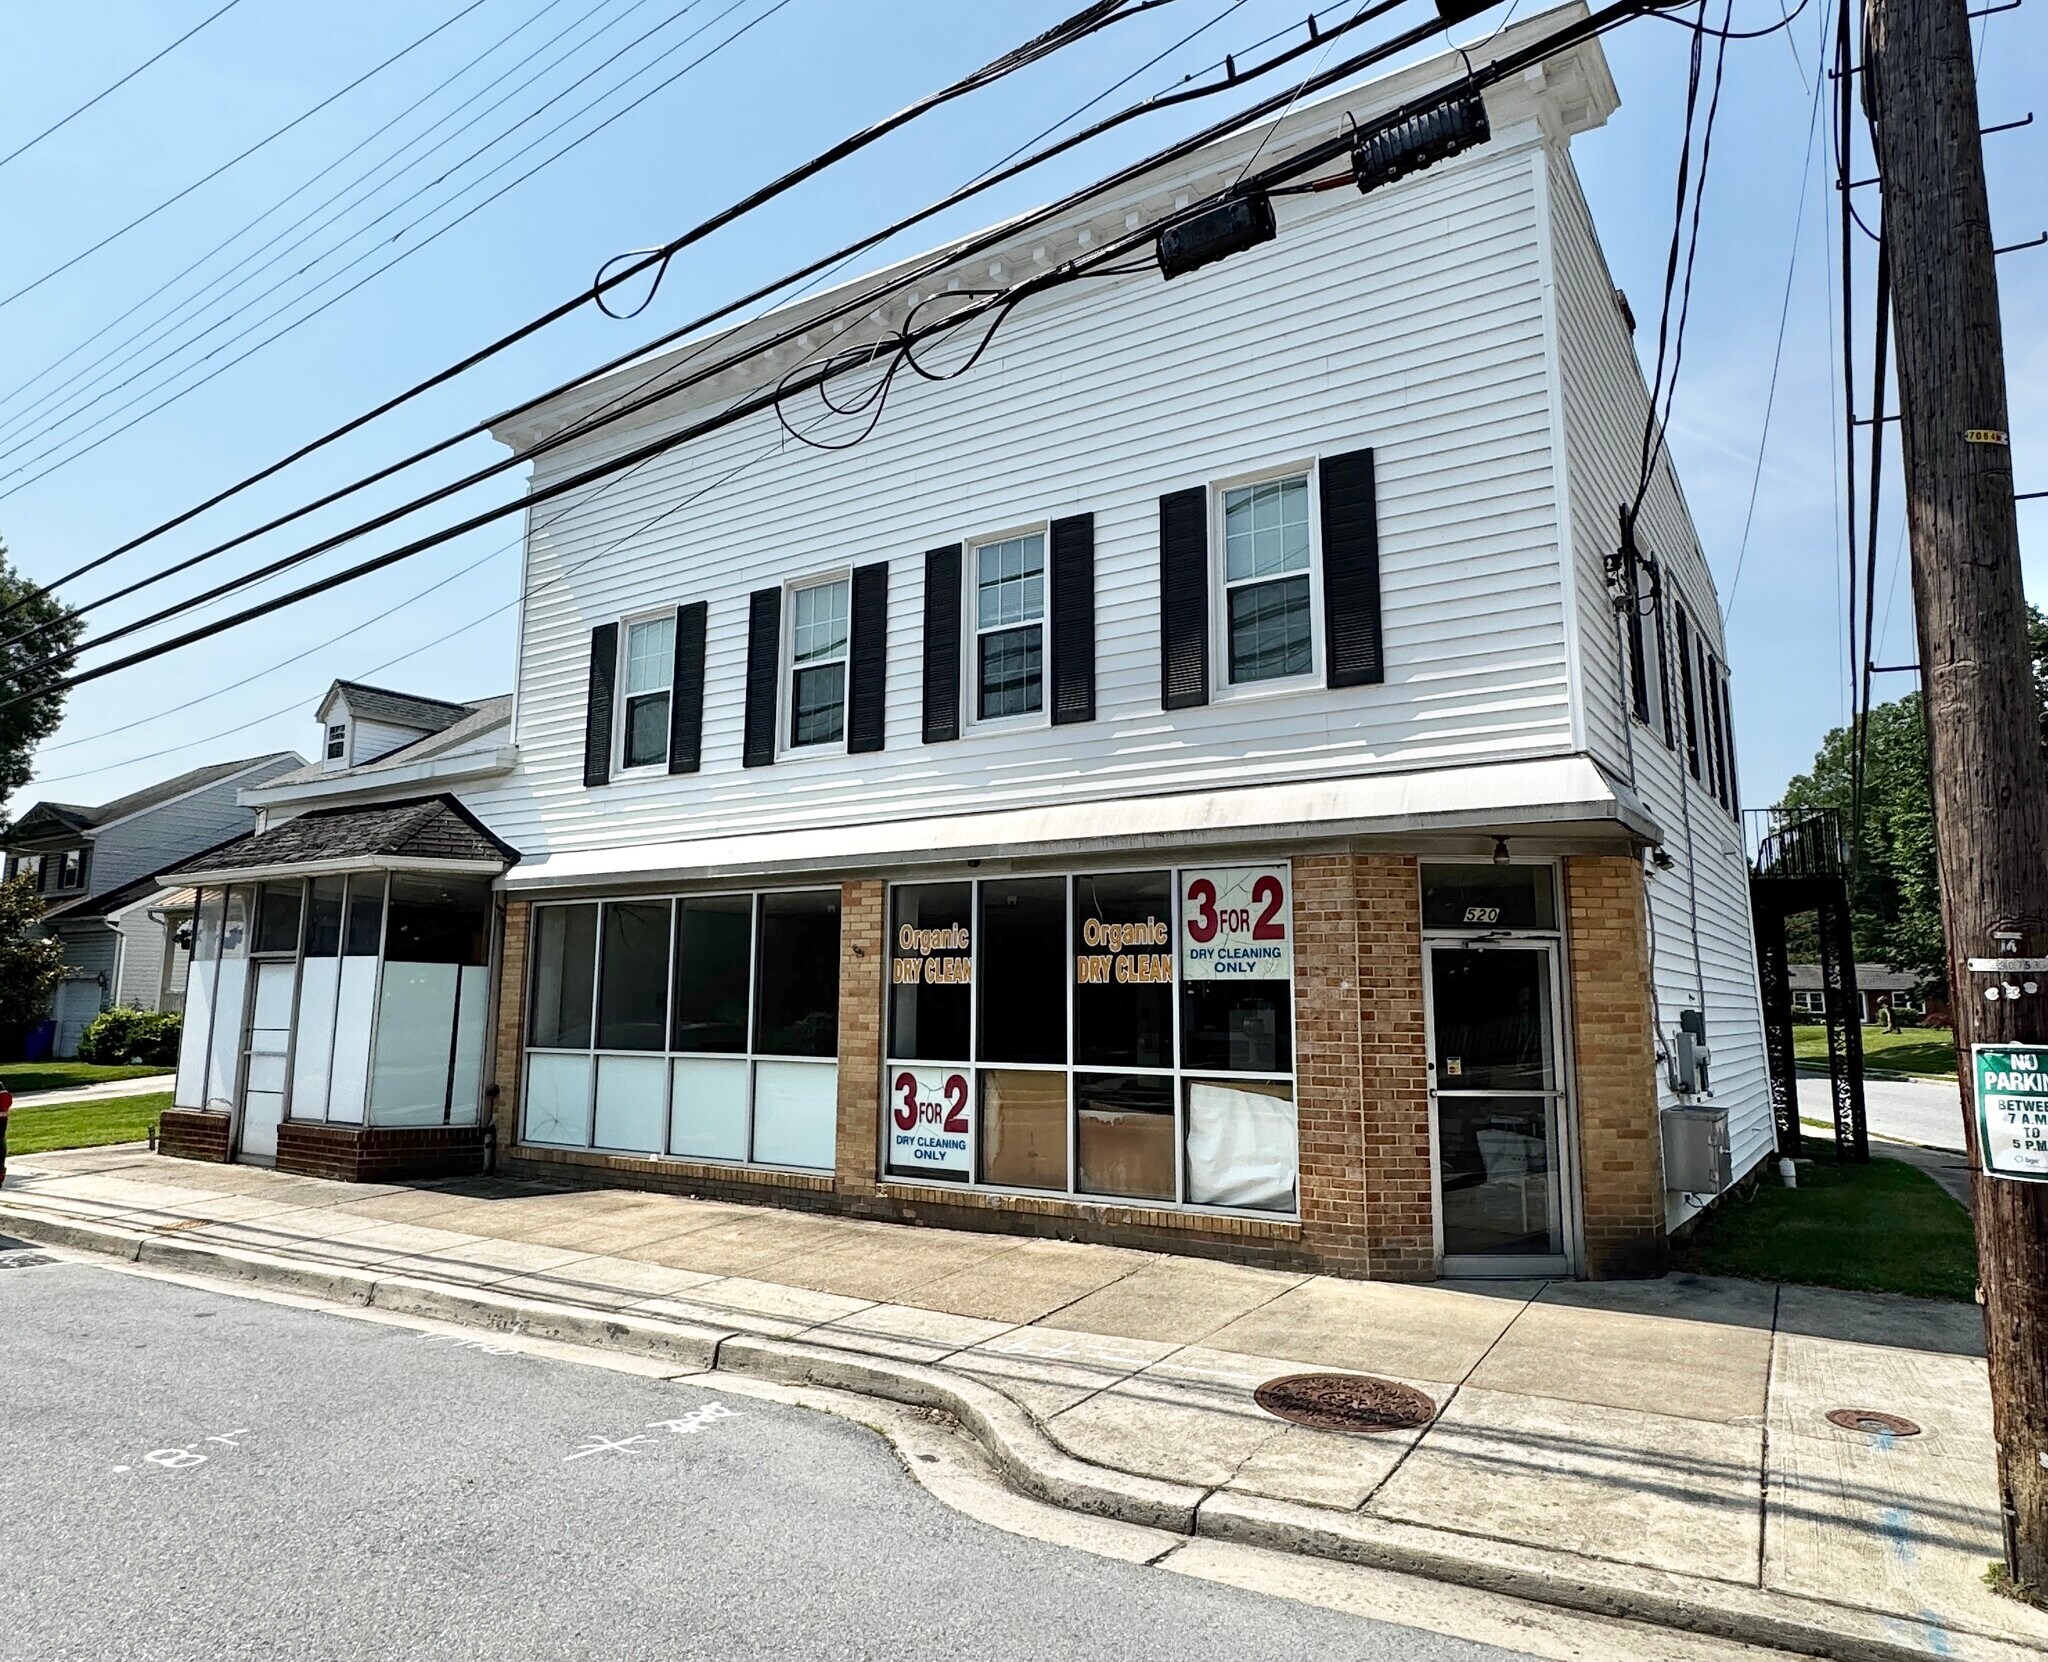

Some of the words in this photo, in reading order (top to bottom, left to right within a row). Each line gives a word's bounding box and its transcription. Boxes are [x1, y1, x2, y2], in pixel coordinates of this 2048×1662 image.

[1187, 878, 1218, 943] 3
[1219, 908, 1250, 933] FOR
[1252, 875, 1285, 940] 2
[1466, 908, 1498, 922] 520
[899, 922, 969, 956] Organic
[1083, 916, 1168, 952] Organic
[1190, 948, 1214, 959] DRY
[1217, 947, 1282, 959] CLEANING
[893, 957, 923, 984] DRY
[924, 957, 972, 984] CLEAN
[1077, 955, 1113, 984] DRY
[1115, 954, 1173, 984] CLEAN
[1214, 961, 1256, 973] ONLY
[2010, 1053, 2039, 1071] NO
[894, 1072, 918, 1131] 3
[919, 1102, 942, 1124] FOR
[943, 1074, 969, 1133] 2
[2008, 1112, 2016, 1124] 7
[2023, 1127, 2040, 1138] TO
[896, 1134, 915, 1146] DRY
[917, 1137, 966, 1150] CLEANING
[2012, 1139, 2021, 1149] 5
[914, 1149, 946, 1161] ONLY
